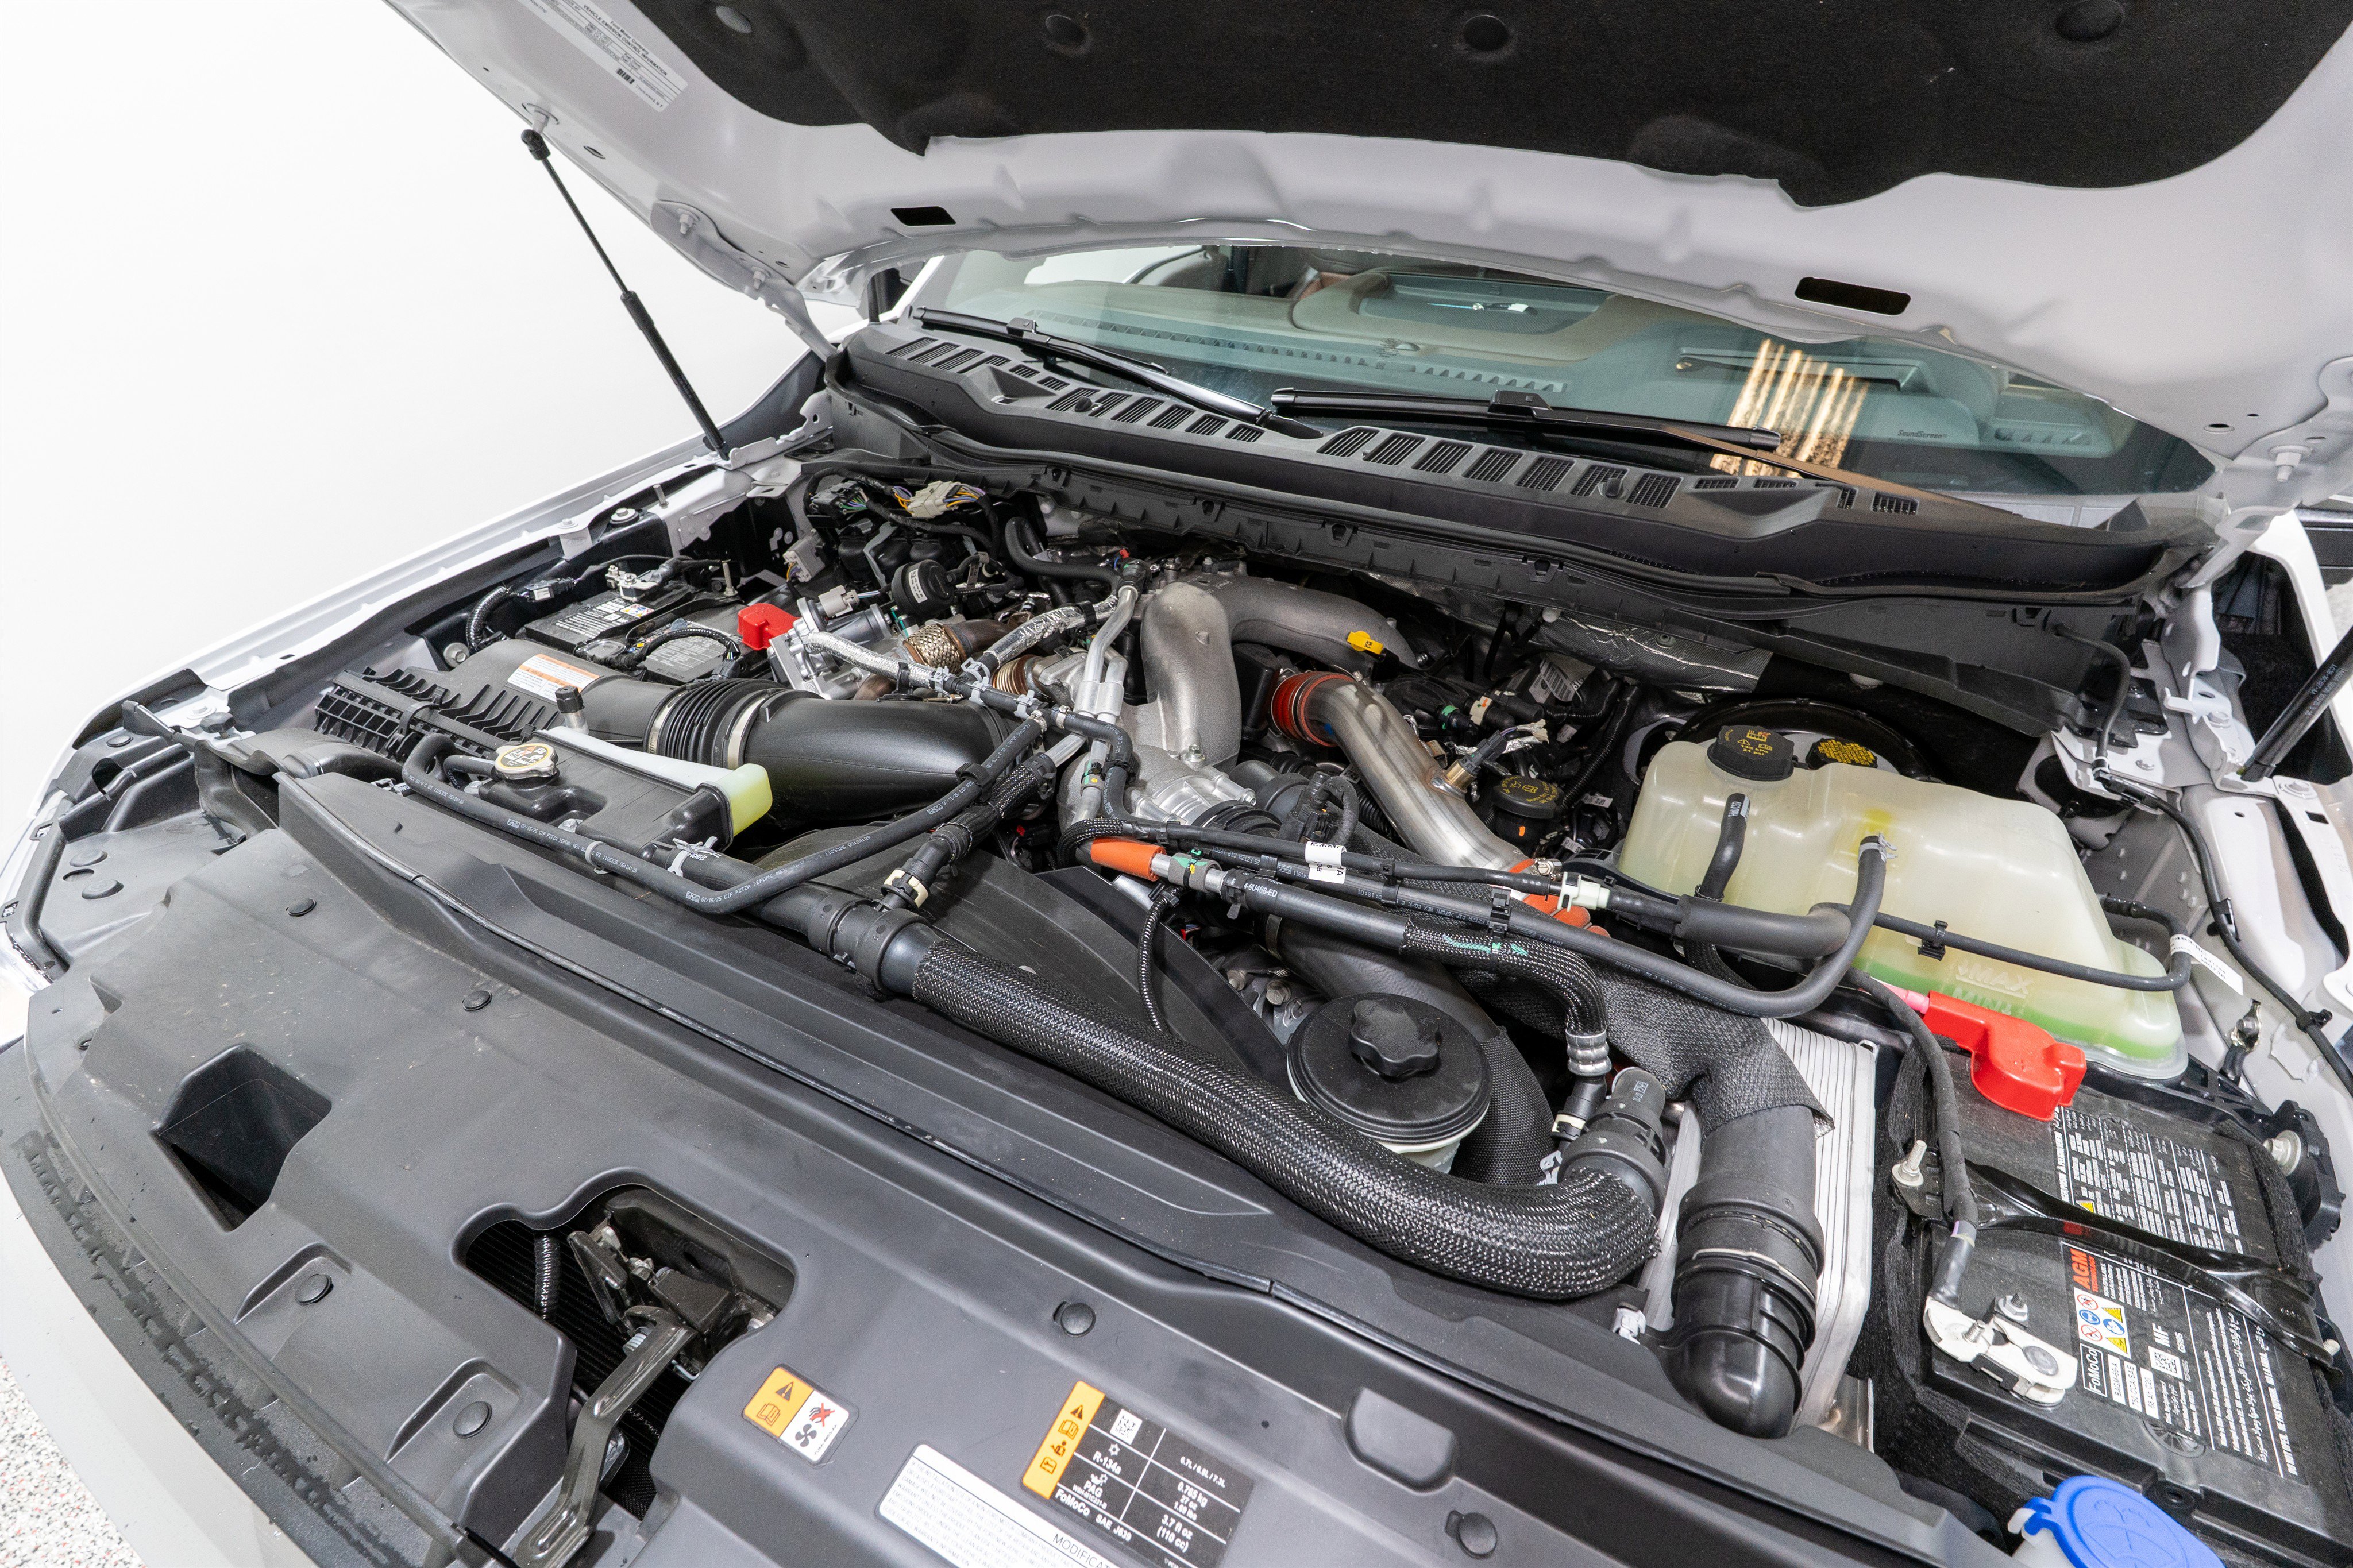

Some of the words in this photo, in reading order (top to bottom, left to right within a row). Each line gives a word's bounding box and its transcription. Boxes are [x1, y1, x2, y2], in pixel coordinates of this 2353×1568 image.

[583, 4, 602, 21] VEHICLE
[601, 20, 622, 38] EMISSION
[621, 36, 642, 55] CONTROL
[641, 53, 668, 76] INFORMATION
[610, 21, 620, 30] Ford
[619, 28, 632, 40] Motor
[630, 38, 650, 55] Company
[1898, 430, 1942, 438] SoundScreen
[1357, 888, 1382, 899] 0:18:01
[1969, 963, 2035, 995] MAX
[2068, 1246, 2092, 1290] AGM
[2086, 1254, 2100, 1293] TECHNOLOGY
[2151, 1322, 2170, 1347] MF
[2083, 1346, 2104, 1394] FoMoCo
[1091, 1450, 1124, 1476] R-134a
[2283, 1450, 2294, 1465] NOT
[2286, 1462, 2297, 1475] DO
[1179, 1455, 1195, 1469] 6.7L
[1211, 1474, 1228, 1488] 7.3L
[1082, 1480, 1104, 1499] PAG
[1175, 1481, 1199, 1500] 0.765
[1194, 1492, 1210, 1508] kg
[1179, 1495, 1190, 1505] 27
[1187, 1500, 1198, 1511] oz
[1054, 1488, 1092, 1517] FoMoCo
[1094, 1513, 1113, 1531] SAE
[1112, 1524, 1133, 1543] J639
[1171, 1501, 1187, 1515] 1.69
[1185, 1508, 1199, 1521] lbs
[1154, 1525, 1176, 1544] (110
[1171, 1536, 1190, 1554] cc)
[1160, 1513, 1175, 1528] 3.7
[1180, 1527, 1194, 1540] oz
